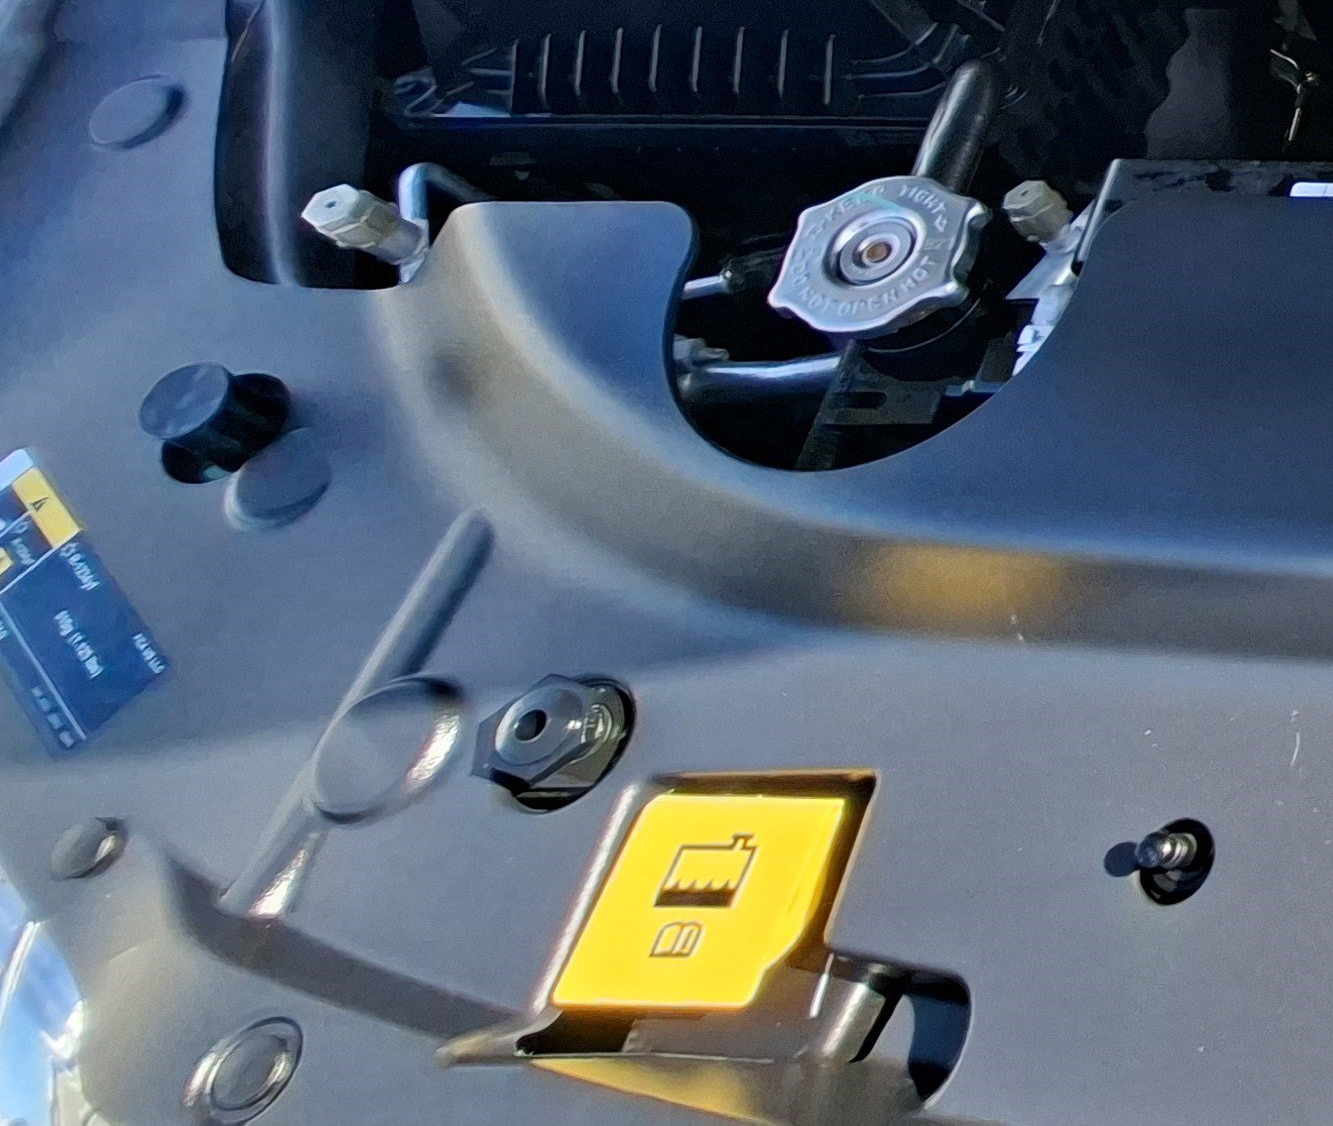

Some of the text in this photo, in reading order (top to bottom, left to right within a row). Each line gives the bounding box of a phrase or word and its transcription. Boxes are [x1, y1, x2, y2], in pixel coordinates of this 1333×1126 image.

[800, 288, 836, 312] NOT
[838, 289, 900, 315] OPEN
[901, 255, 935, 293] HOT
